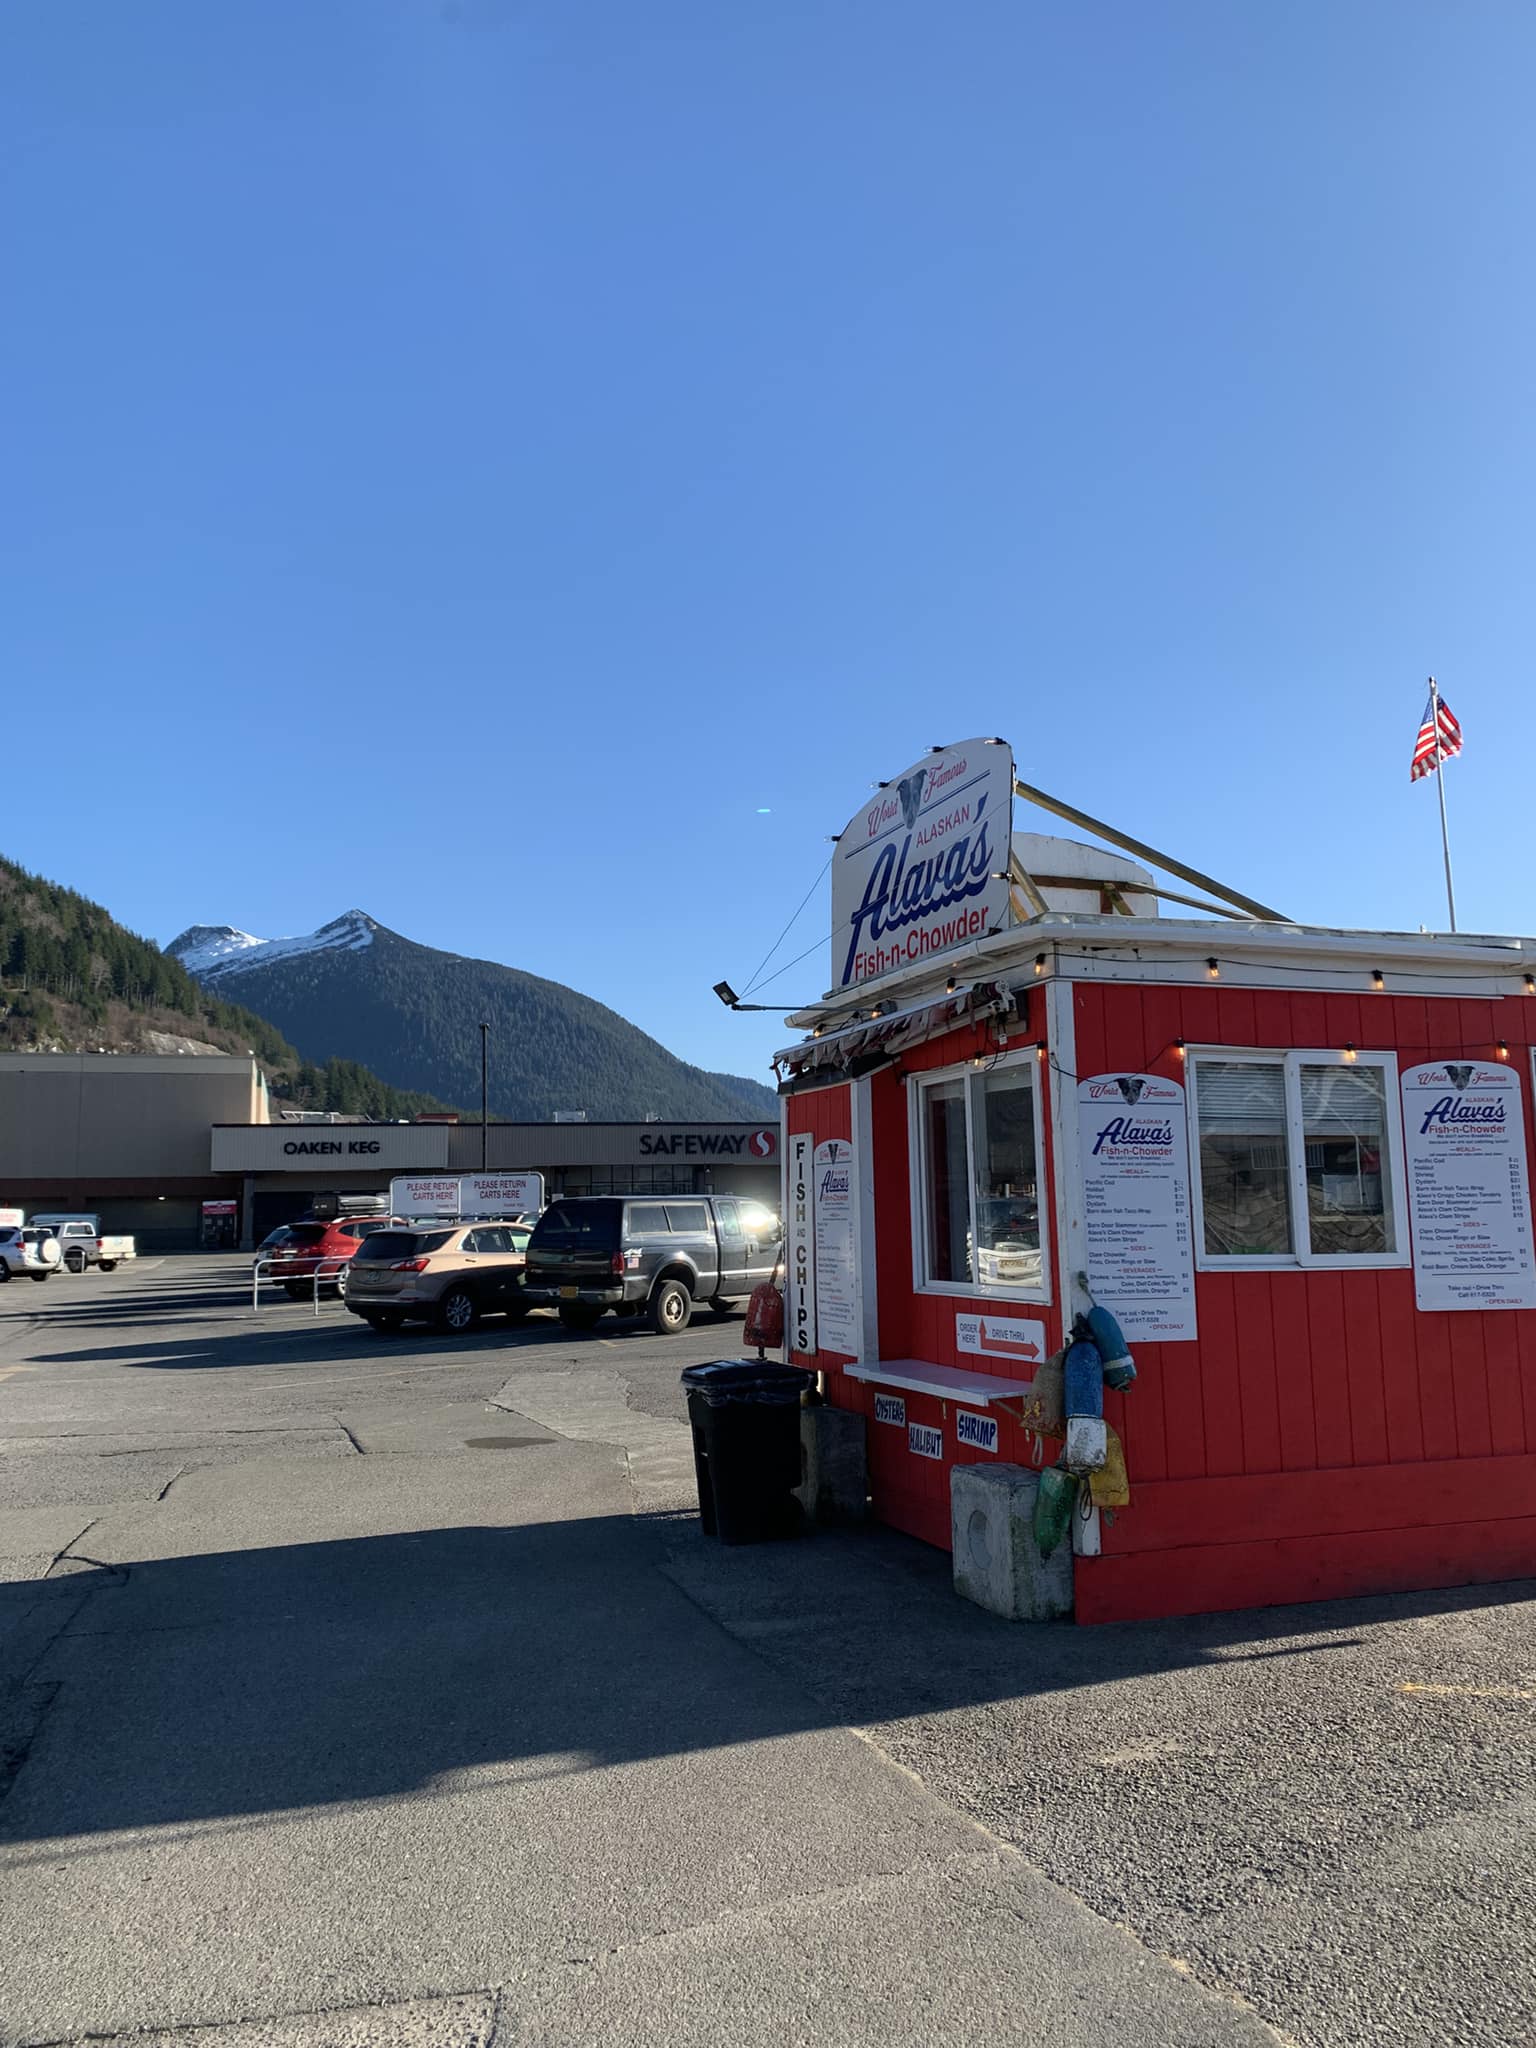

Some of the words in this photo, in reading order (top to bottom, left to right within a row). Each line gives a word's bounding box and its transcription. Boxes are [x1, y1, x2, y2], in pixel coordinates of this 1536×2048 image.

[867, 797, 898, 838] World
[924, 758, 967, 802] Famous
[916, 803, 970, 848] ALASKAN
[855, 906, 989, 981] Fish-n-Chowder
[1418, 1072, 1447, 1085] World
[1089, 1085, 1118, 1098] World
[1420, 1096, 1507, 1134] Alava's
[1092, 1117, 1174, 1155] Alava's
[1429, 1125, 1506, 1133] Fish-n-Chowder
[283, 1141, 342, 1155] OAKEN
[348, 1140, 381, 1154] KEG
[639, 1133, 747, 1155] SAFEWAY
[1101, 1146, 1173, 1156] Fish-n-Chowder
[406, 1182, 432, 1191] PLEASE
[474, 1180, 497, 1189] PLEASE
[499, 1179, 527, 1188] RETURN
[796, 1141, 806, 1222] FISH
[412, 1191, 435, 1200] CARTS
[436, 1191, 454, 1200] HERE
[479, 1190, 501, 1199] CARTS
[502, 1189, 520, 1198] HERE
[796, 1245, 808, 1349] CHIPS
[959, 1322, 977, 1334] ORDER
[991, 1328, 1008, 1340] DRIVE
[1009, 1329, 1025, 1341] THRU
[961, 1333, 976, 1344] HERE
[875, 1397, 904, 1423] OYSTERS
[958, 1414, 996, 1446] SHRIMP
[909, 1426, 942, 1457] HALIBUT
